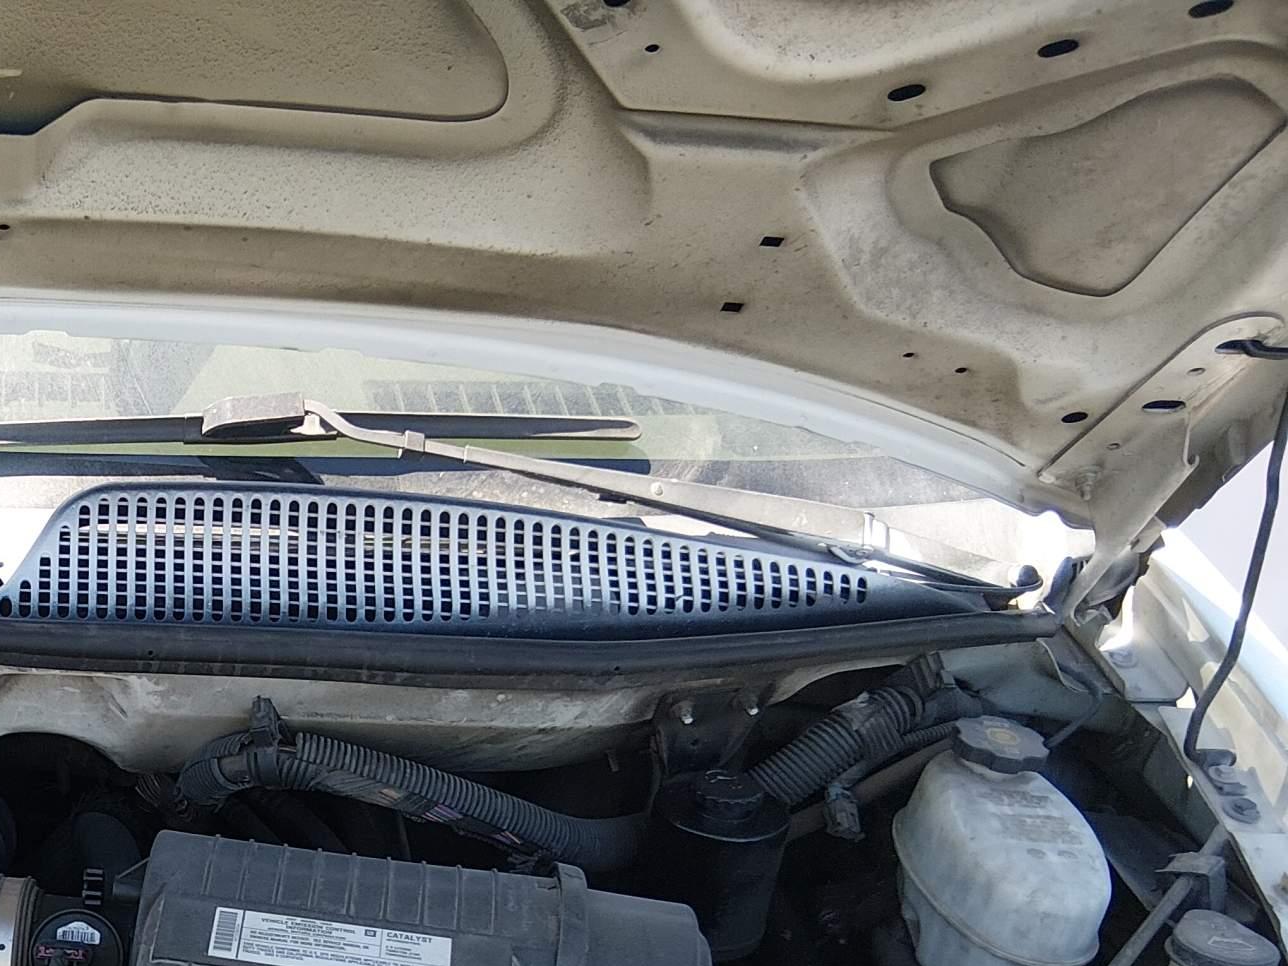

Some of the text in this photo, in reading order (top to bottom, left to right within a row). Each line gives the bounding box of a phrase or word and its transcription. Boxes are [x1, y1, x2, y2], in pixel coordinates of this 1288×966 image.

[291, 921, 323, 929] EMISSION
[325, 925, 356, 934] CONTROL
[386, 931, 433, 944] CATALYST
